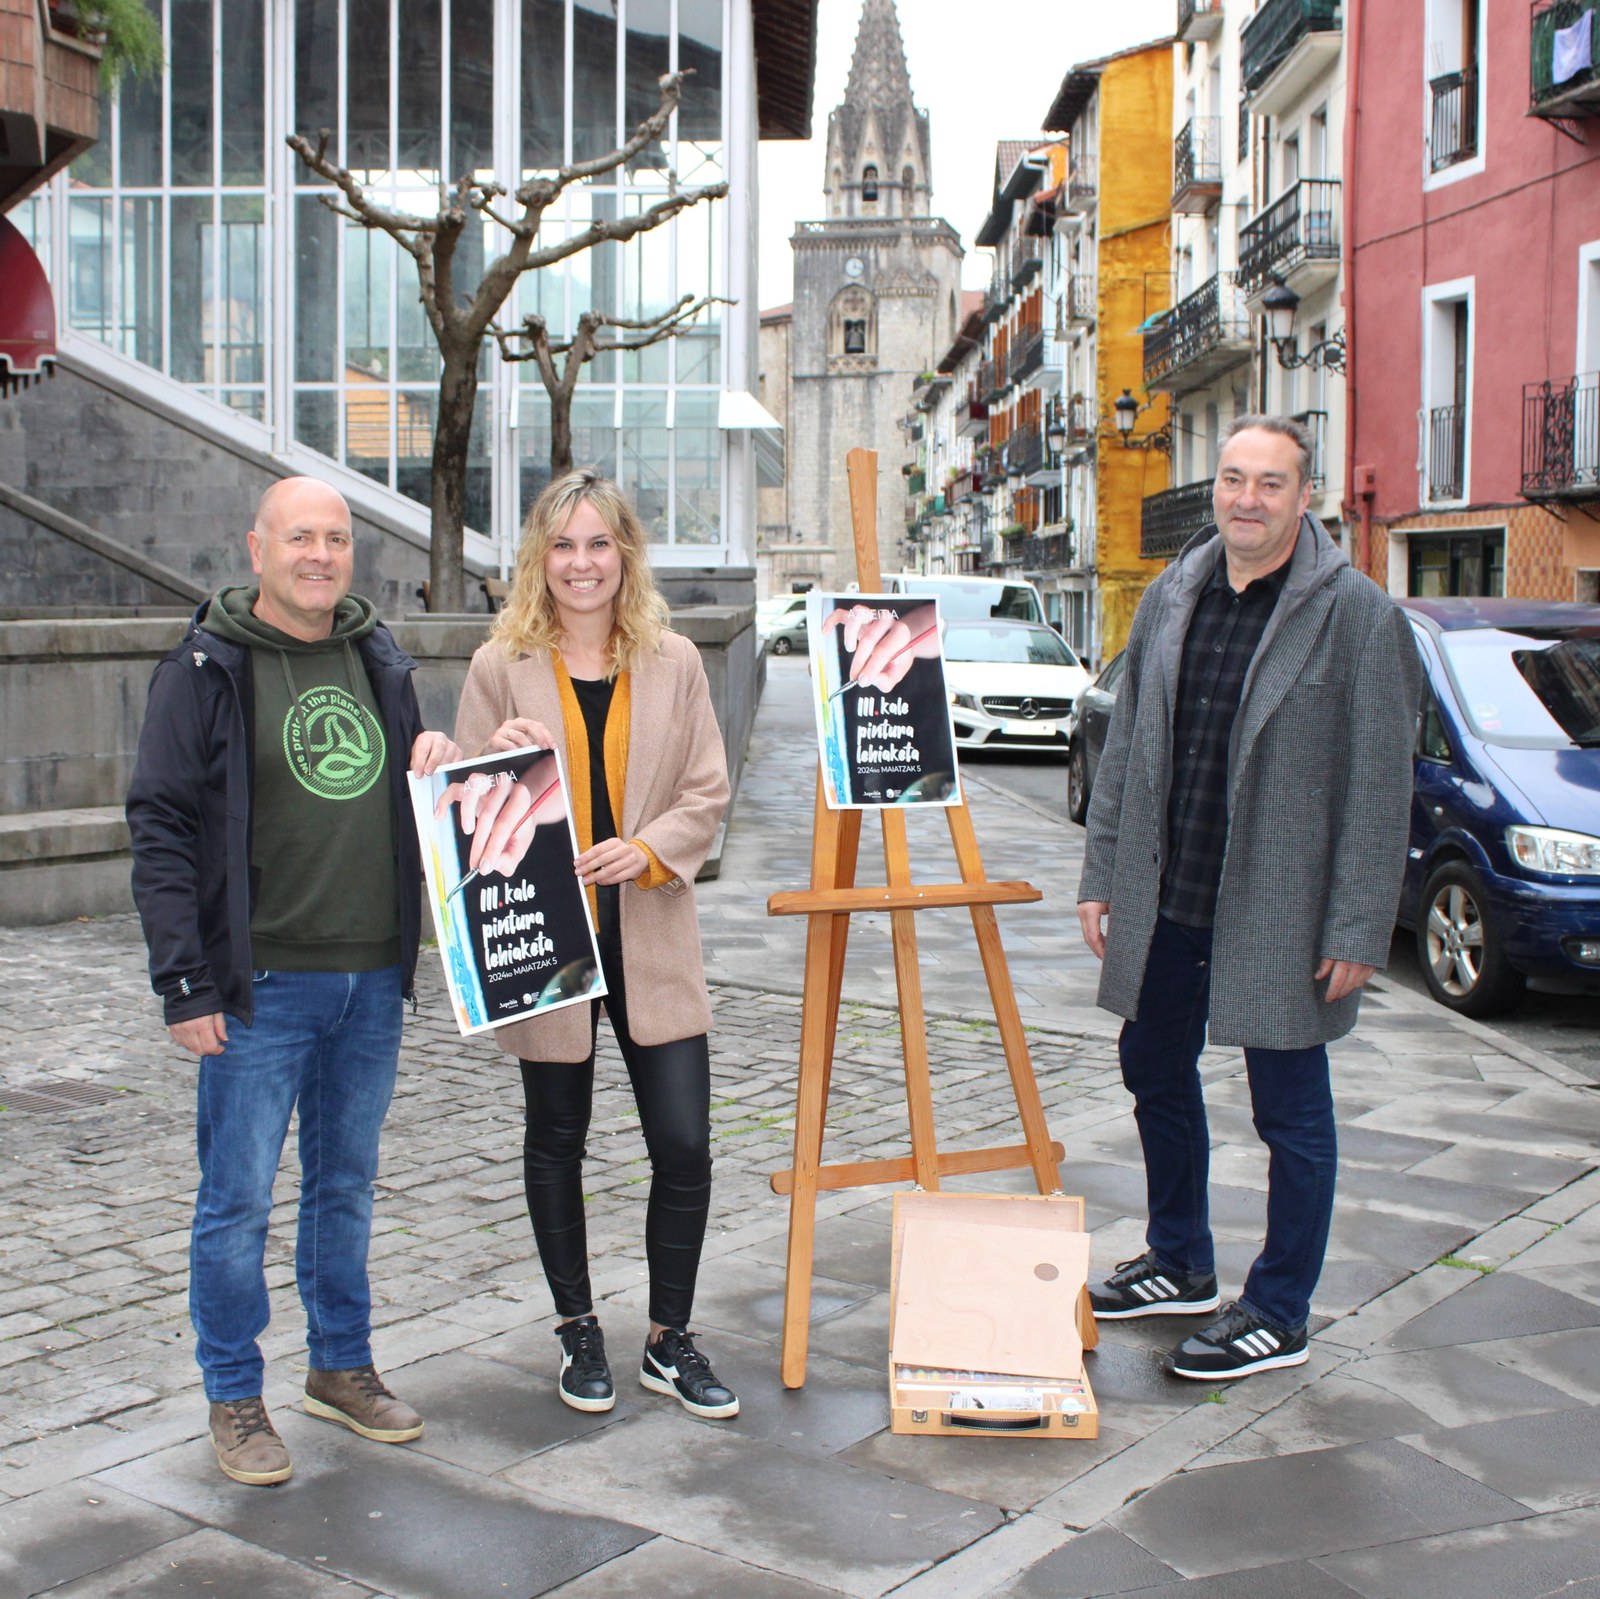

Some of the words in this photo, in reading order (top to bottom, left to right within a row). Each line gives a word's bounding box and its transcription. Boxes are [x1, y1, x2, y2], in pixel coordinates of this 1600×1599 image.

[857, 696, 879, 717] III.
[880, 696, 910, 716] kale
[296, 755, 309, 774] we
[307, 694, 327, 707] the
[330, 693, 364, 720] plane
[857, 719, 914, 745] pintura
[856, 742, 920, 765] lehiaketa
[881, 765, 916, 774] MAIATZAK
[916, 764, 922, 772] 5
[480, 887, 504, 912] III.
[504, 878, 537, 906] kale
[482, 910, 545, 946] pintura
[484, 931, 554, 971] lehiaketa
[487, 970, 513, 984] 2024ko
[513, 959, 553, 977] MAIATZAK
[552, 958, 558, 967] 5
